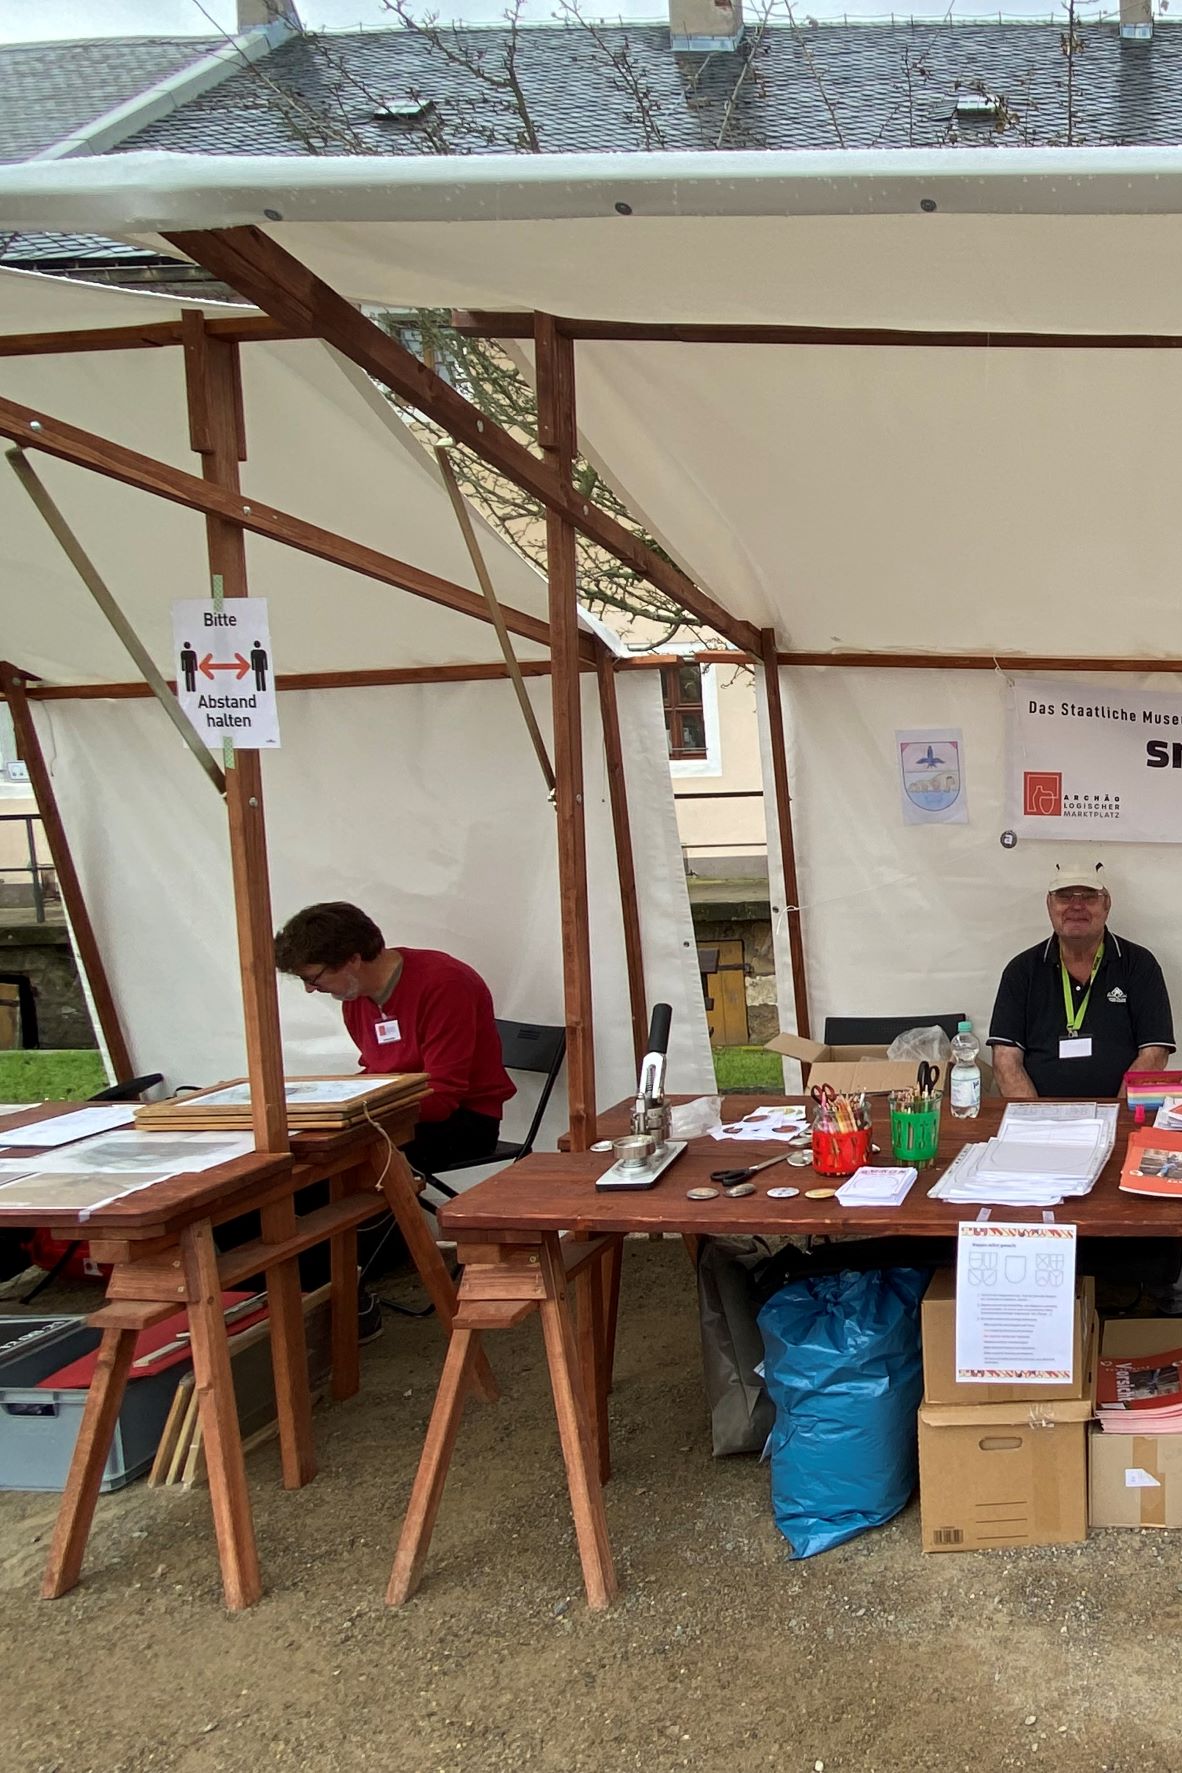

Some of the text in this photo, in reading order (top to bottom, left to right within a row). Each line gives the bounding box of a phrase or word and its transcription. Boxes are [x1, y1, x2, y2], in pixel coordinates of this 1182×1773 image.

[203, 611, 237, 627] Bitte
[198, 694, 257, 709] Abstand
[1029, 701, 1055, 715] Das
[1061, 703, 1137, 722] Staatliche
[206, 713, 252, 728] halten
[1063, 811, 1120, 819] MARKTPLATZ
